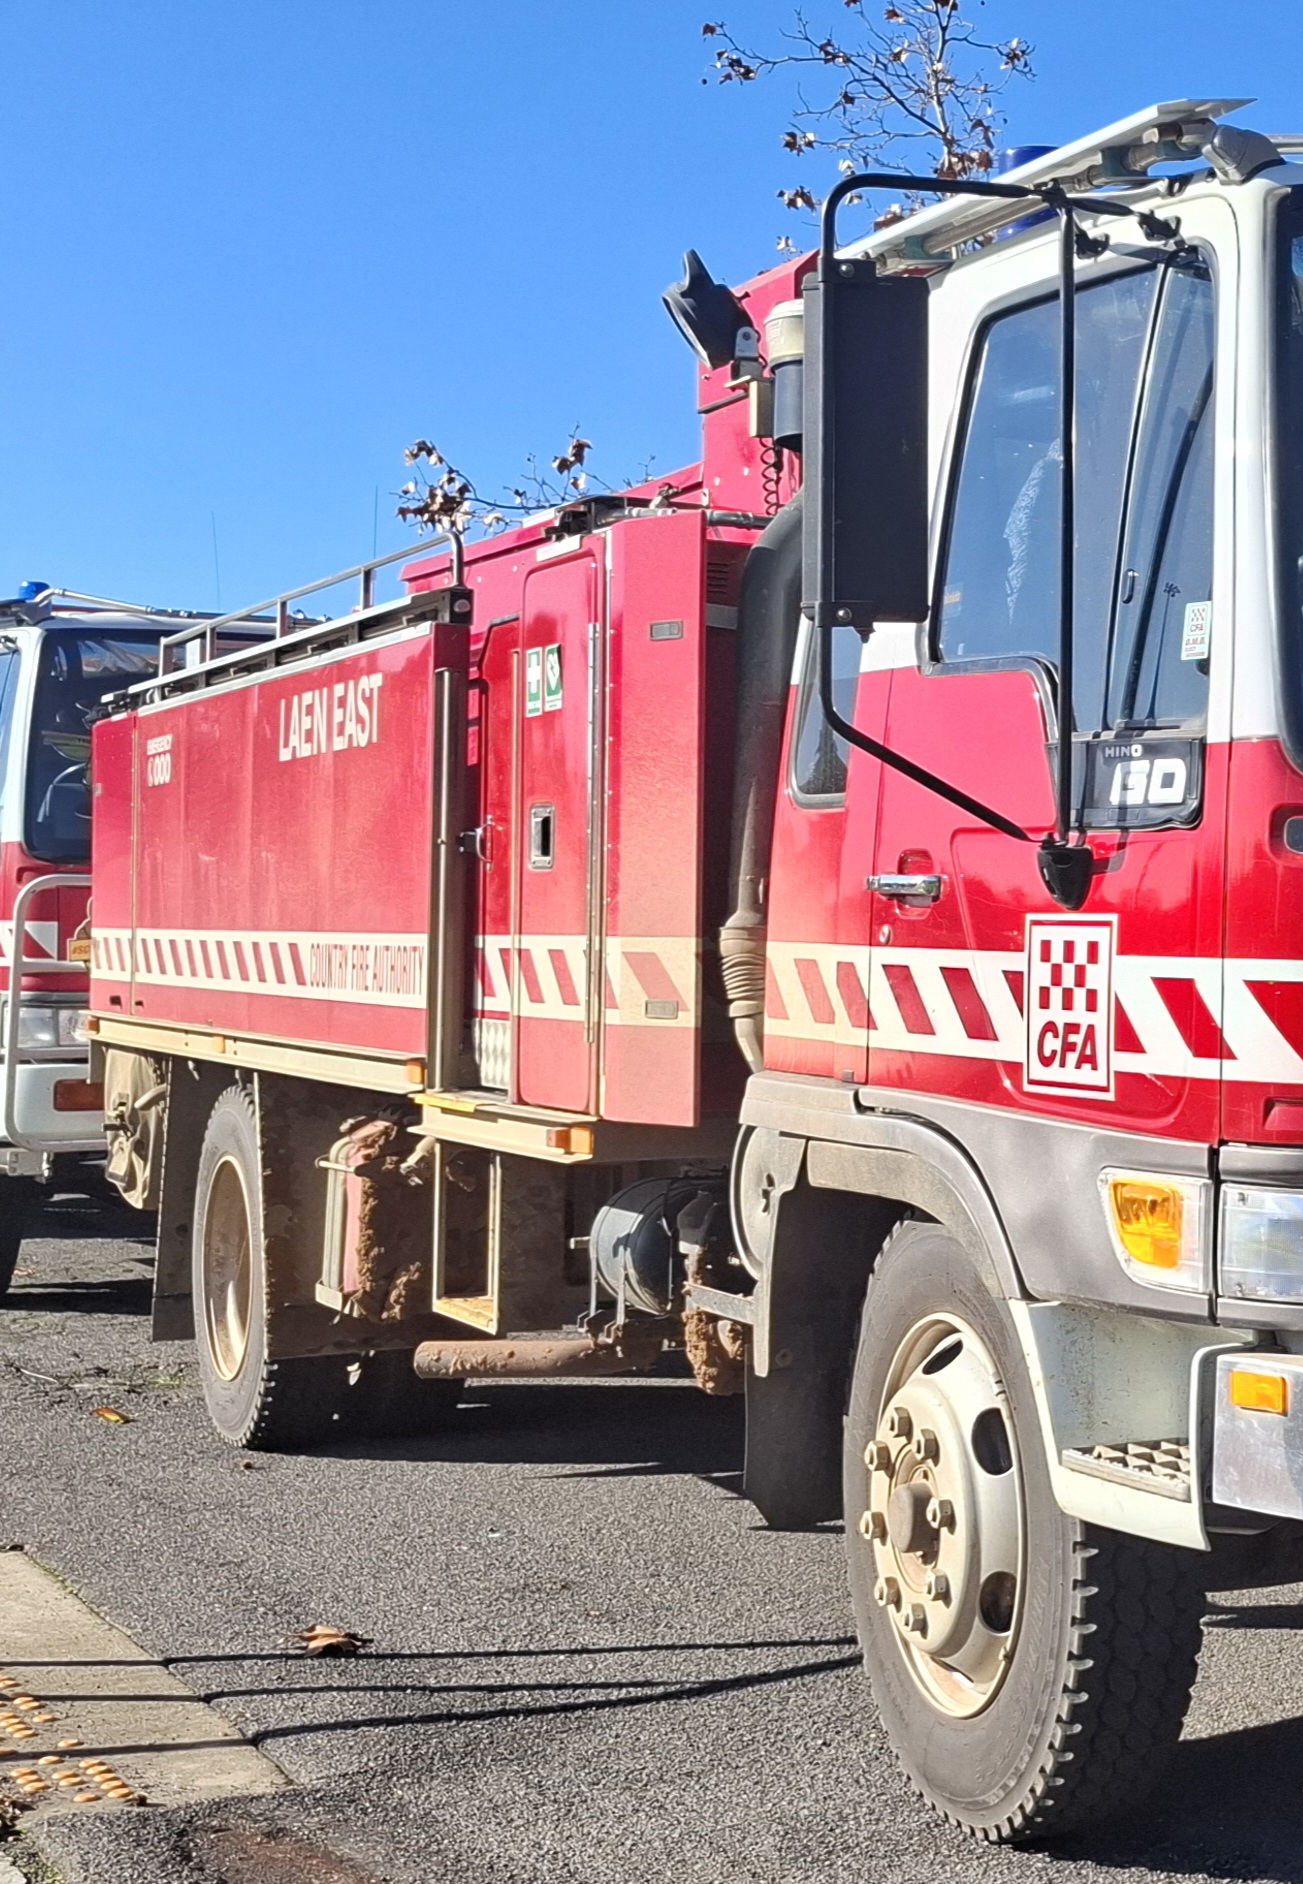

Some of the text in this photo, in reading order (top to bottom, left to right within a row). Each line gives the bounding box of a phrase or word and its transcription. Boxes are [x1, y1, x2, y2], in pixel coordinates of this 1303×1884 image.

[279, 673, 383, 762] LAEN EAST
[1105, 744, 1142, 758] HINO
[310, 943, 424, 995] COUNTRY FIRE AUTHORITY
[1037, 1020, 1098, 1071] CFA
